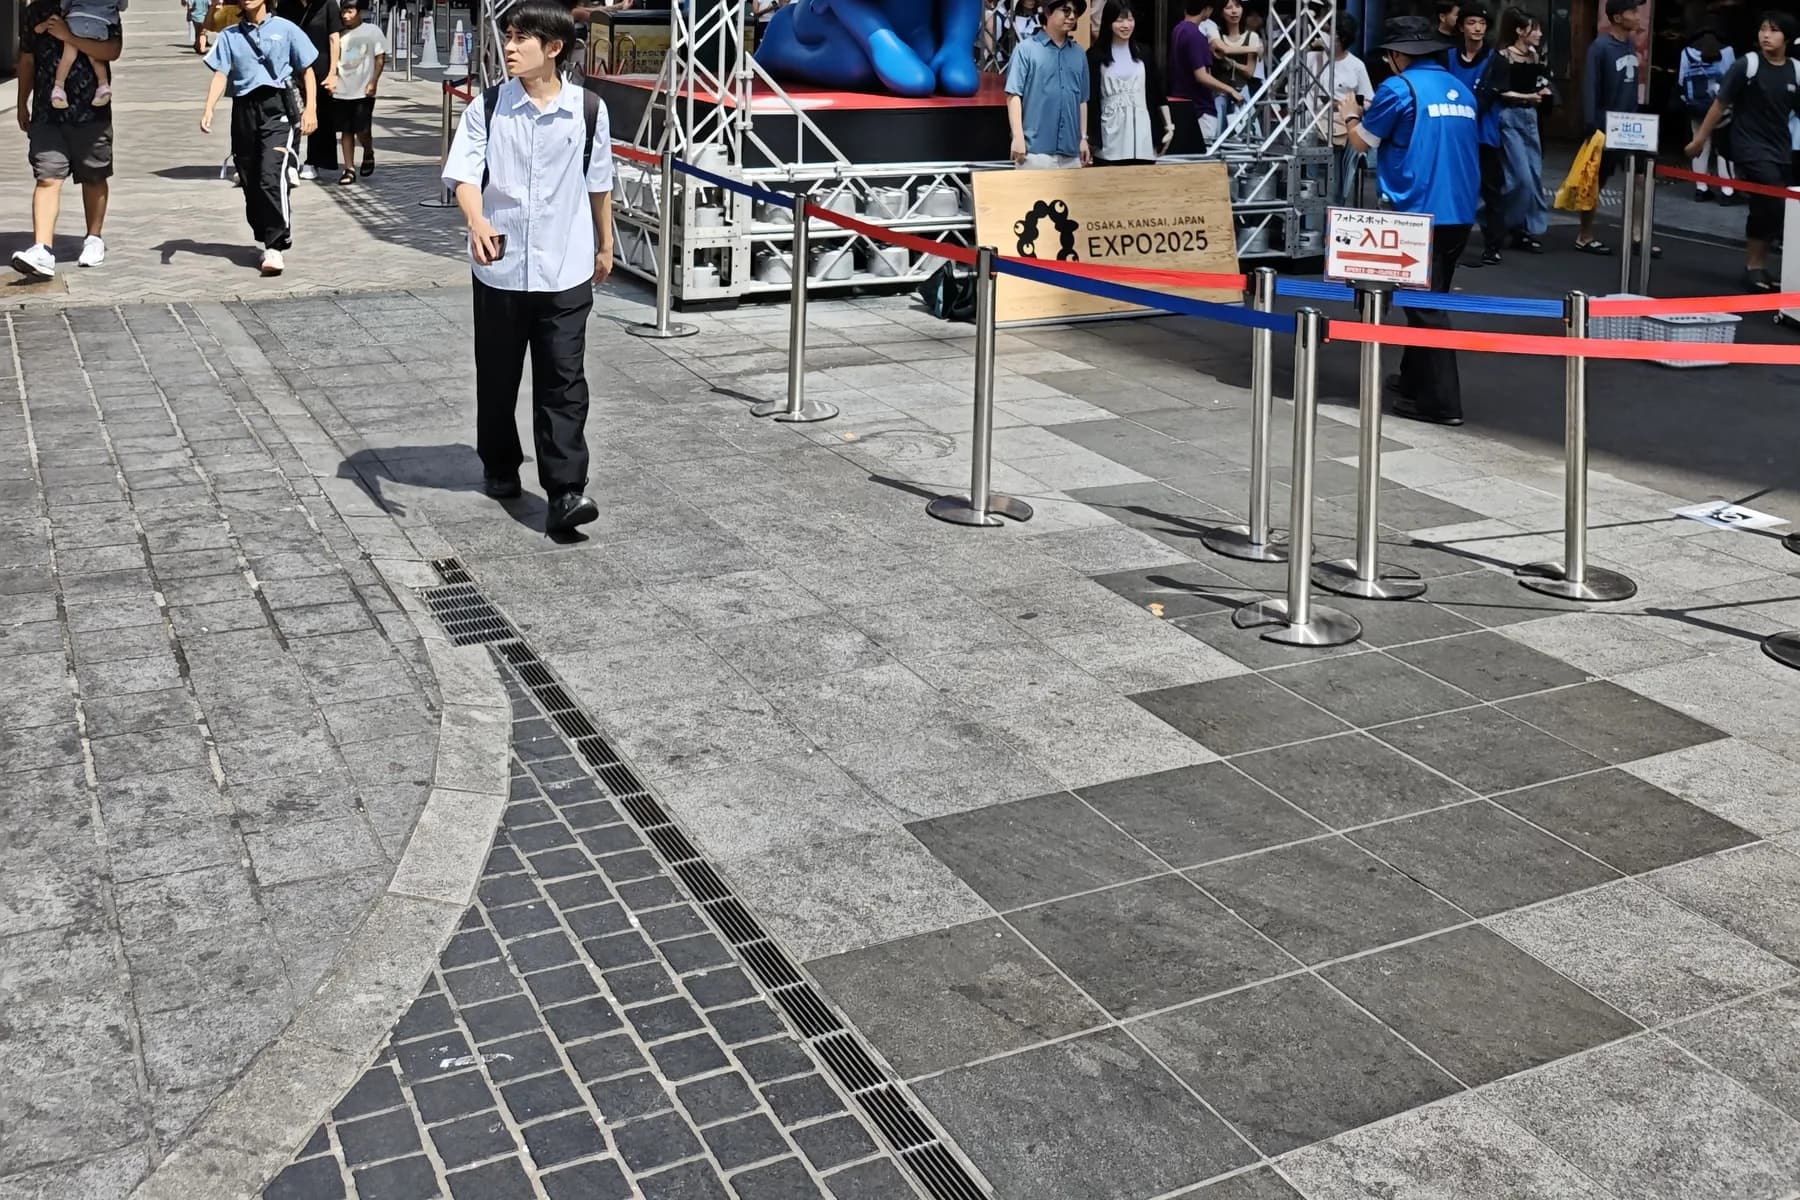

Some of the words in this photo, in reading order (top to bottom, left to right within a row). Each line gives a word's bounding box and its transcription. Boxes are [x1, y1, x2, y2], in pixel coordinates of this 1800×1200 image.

[1621, 122, 1643, 134] 出口
[1086, 221, 1126, 232] OSAKA,
[1128, 217, 1170, 229] KANSAI,
[1172, 215, 1206, 227] JAPAN
[1334, 212, 1389, 226] フォトスポット
[1087, 229, 1209, 259] EXPO2025
[1360, 227, 1399, 249] 入口
